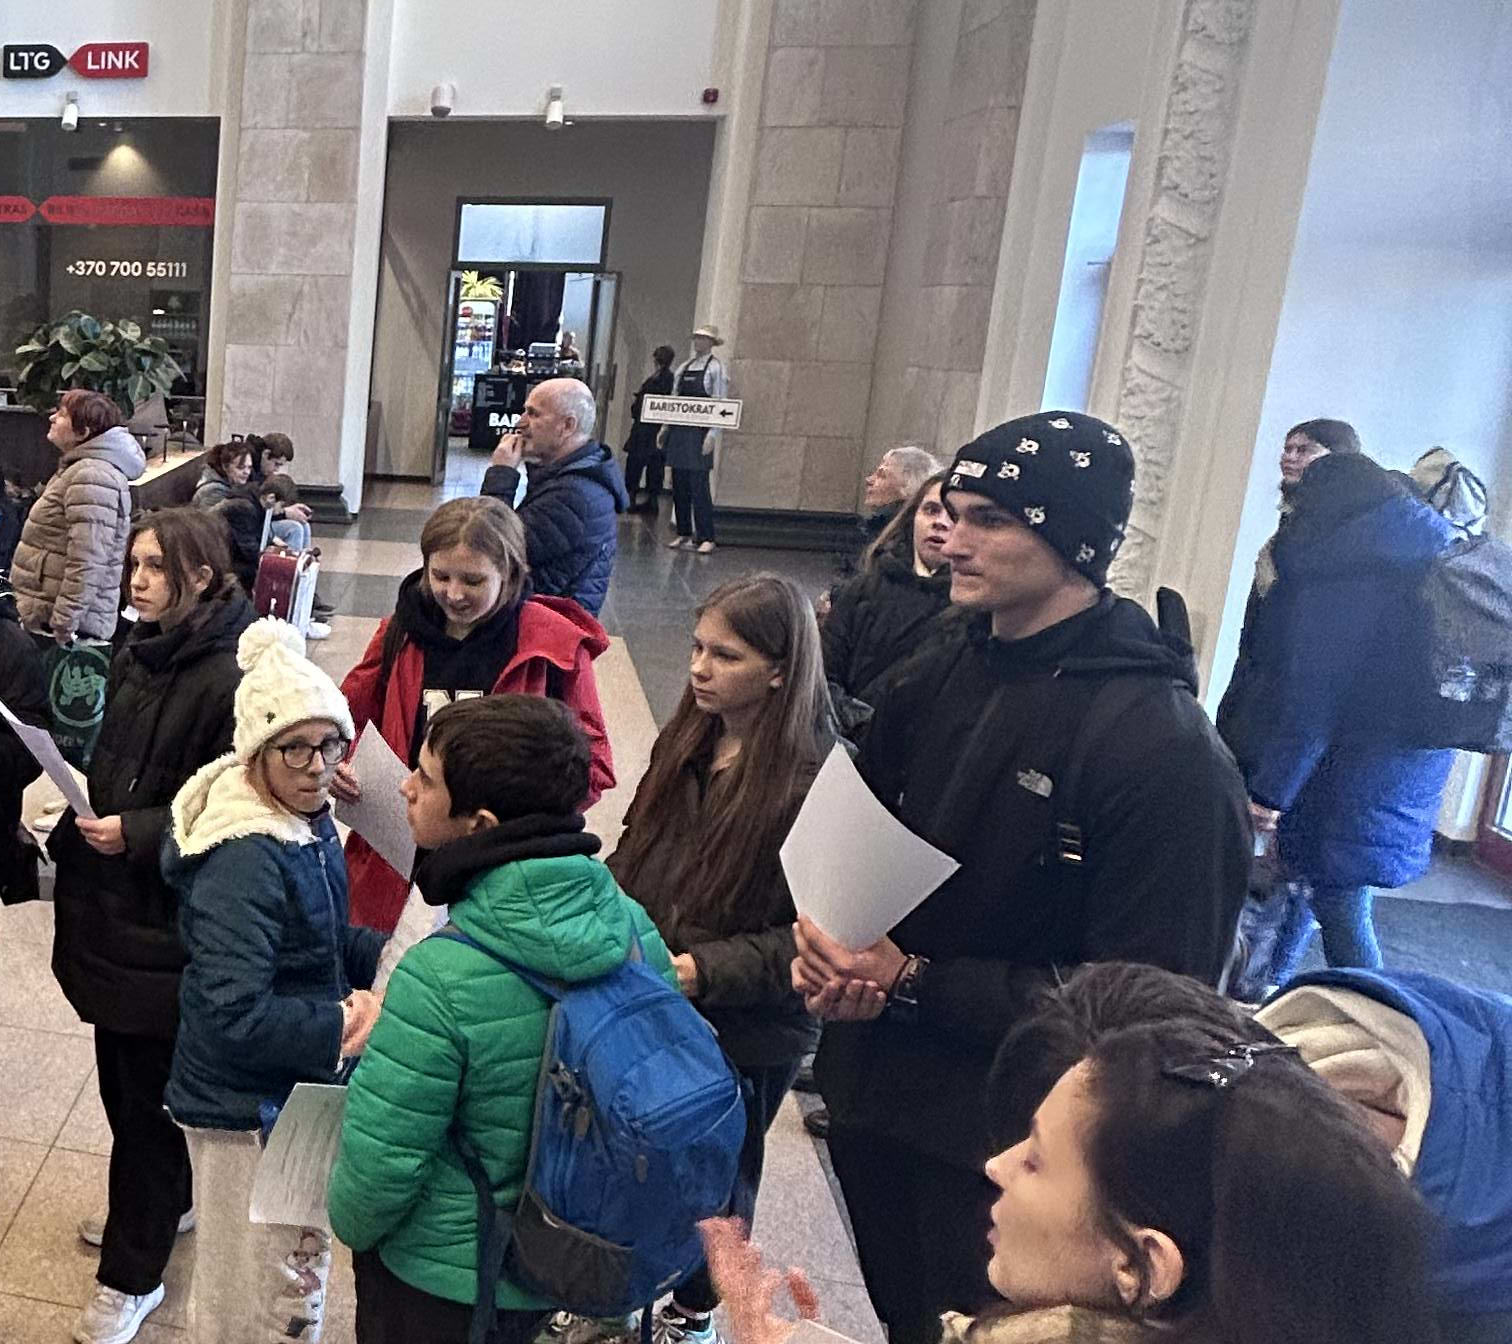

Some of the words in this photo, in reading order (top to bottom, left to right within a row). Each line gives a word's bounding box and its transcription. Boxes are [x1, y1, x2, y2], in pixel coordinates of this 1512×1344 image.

[9, 51, 51, 70] LTG
[87, 50, 140, 70] LINK
[66, 260, 106, 277] +370
[110, 261, 142, 277] 700
[146, 261, 187, 277] 55111
[649, 401, 716, 414] BARISTOKRAT
